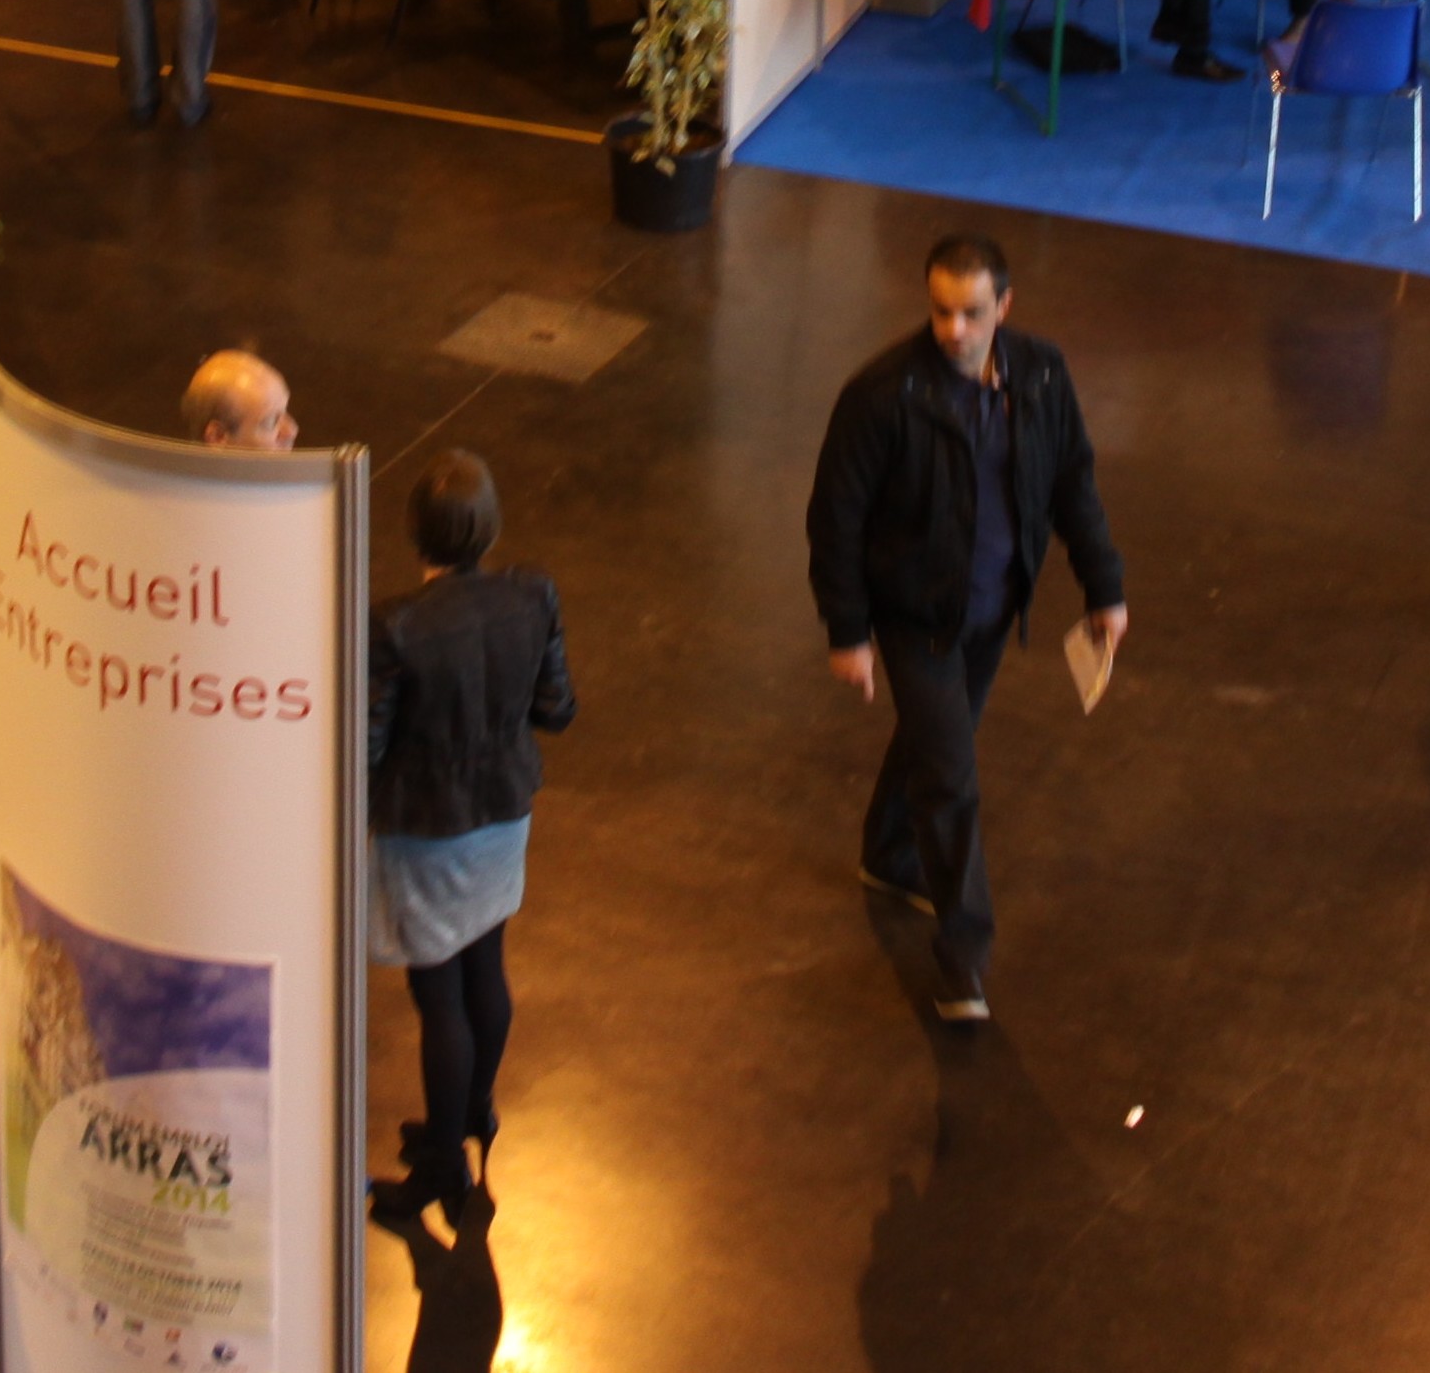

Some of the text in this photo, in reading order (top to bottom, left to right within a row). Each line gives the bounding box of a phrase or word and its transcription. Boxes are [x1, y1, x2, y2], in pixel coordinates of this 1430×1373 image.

[15, 510, 230, 628] Accueil
[79, 1111, 233, 1187] ARRAS
[151, 1181, 232, 1214] 2014
